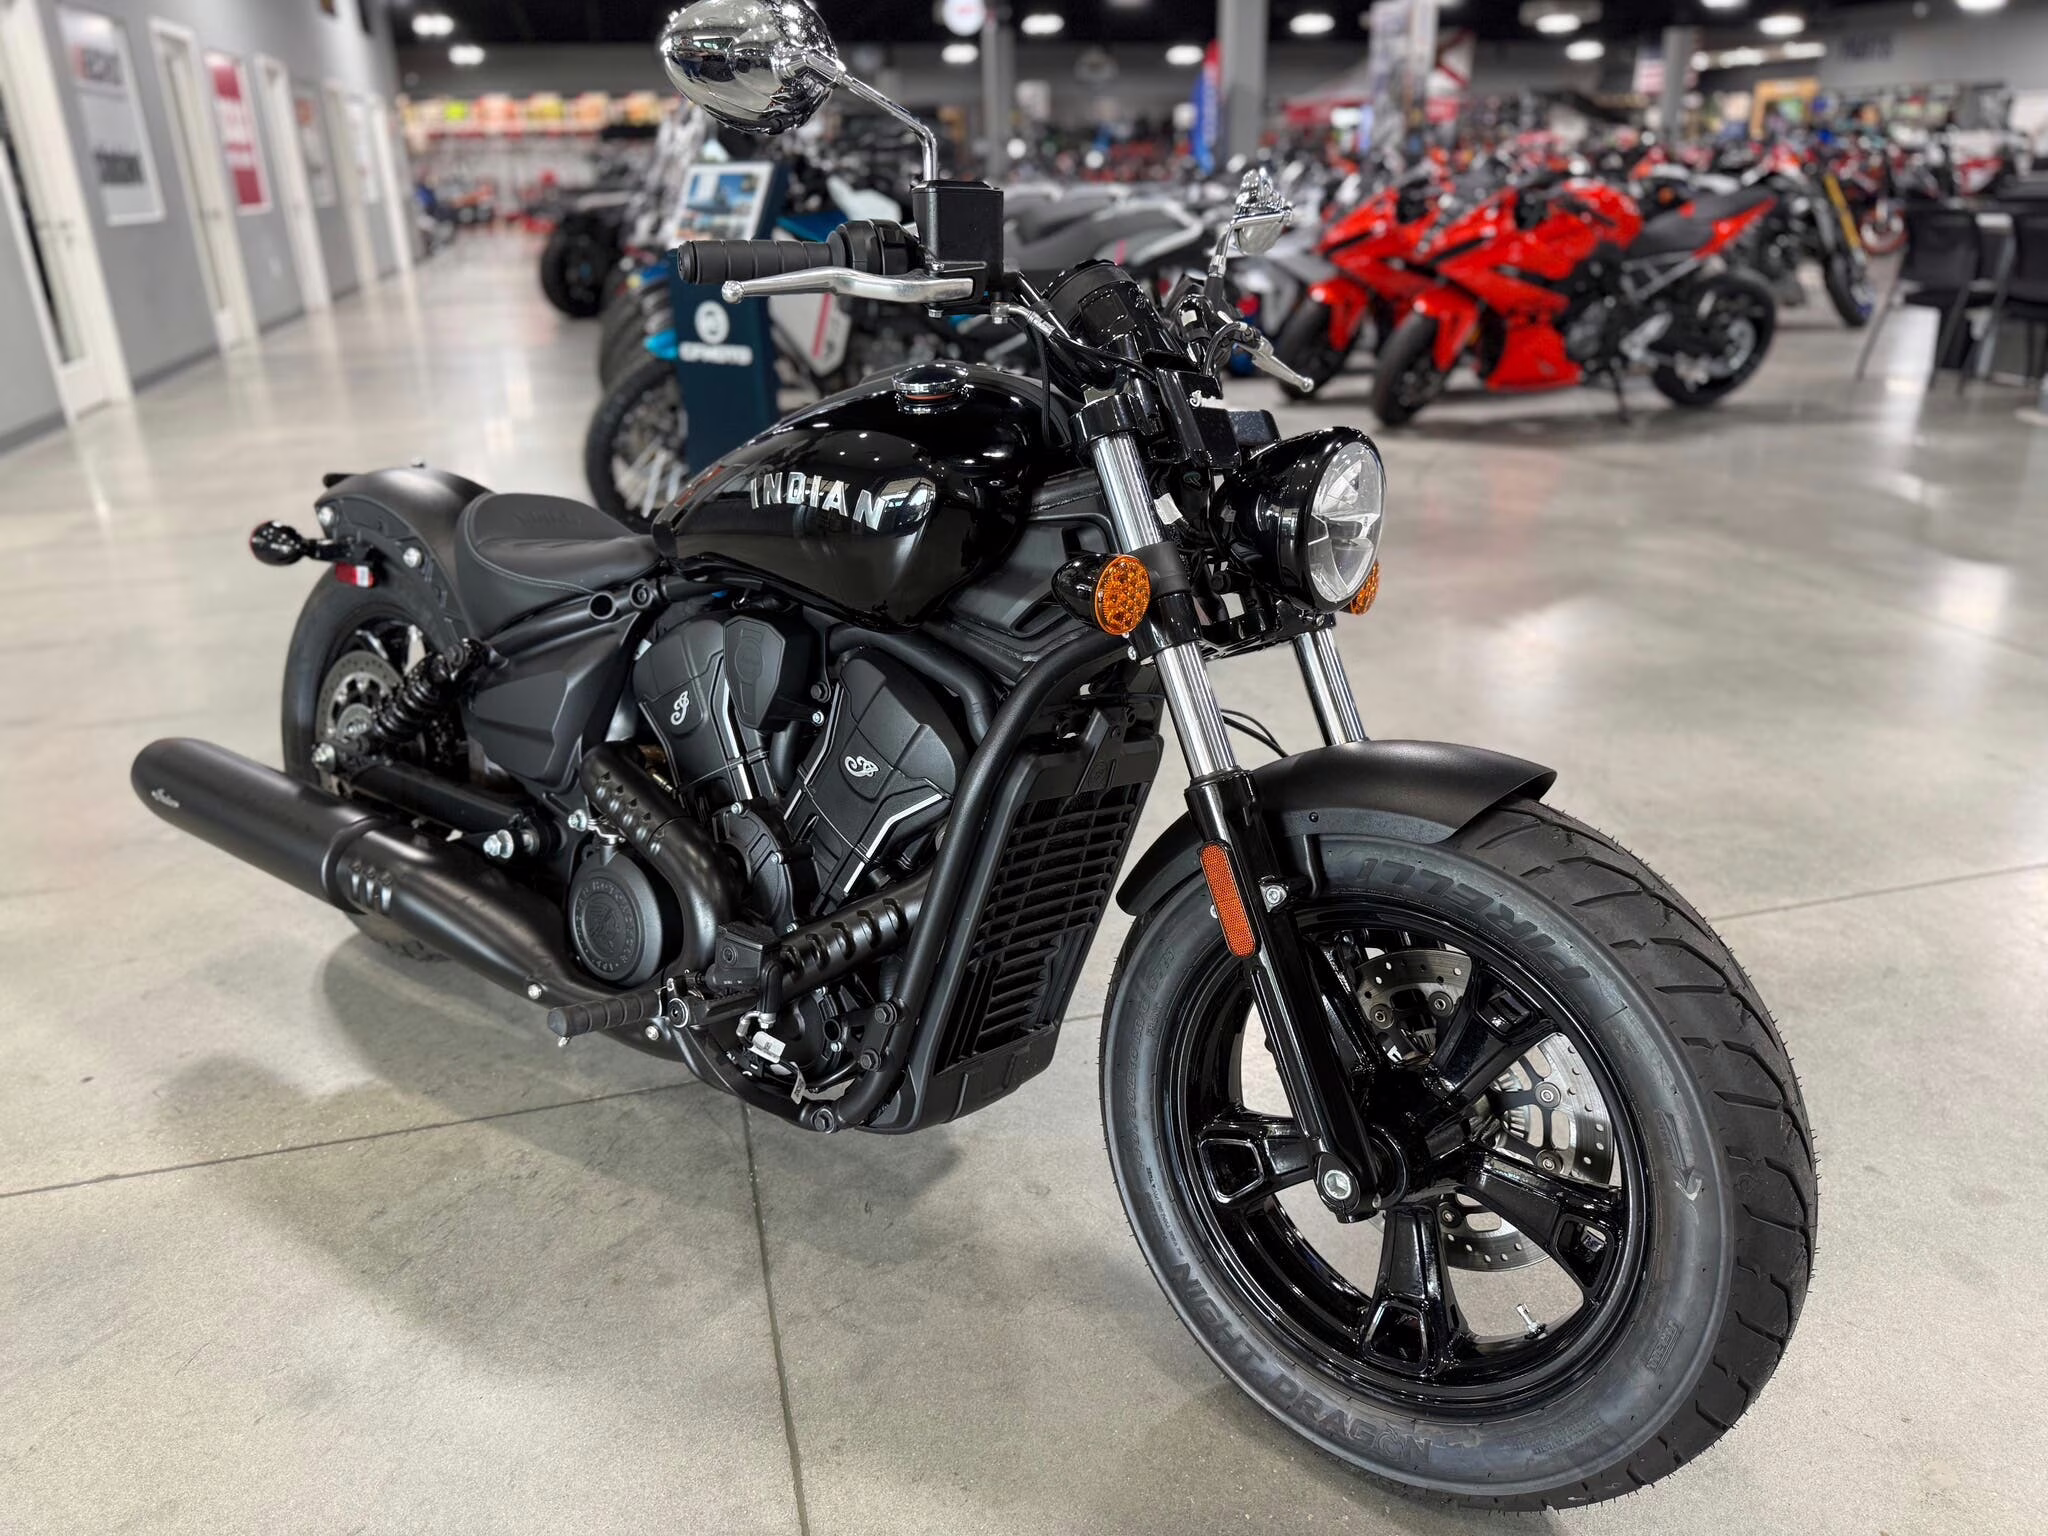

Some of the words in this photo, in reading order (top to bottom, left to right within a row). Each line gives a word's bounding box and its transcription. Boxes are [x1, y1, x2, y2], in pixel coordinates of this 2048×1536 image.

[750, 471, 889, 530] INDIAN
[1170, 1262, 1268, 1374] NIGHT
[1267, 1373, 1433, 1465] DRAGON
